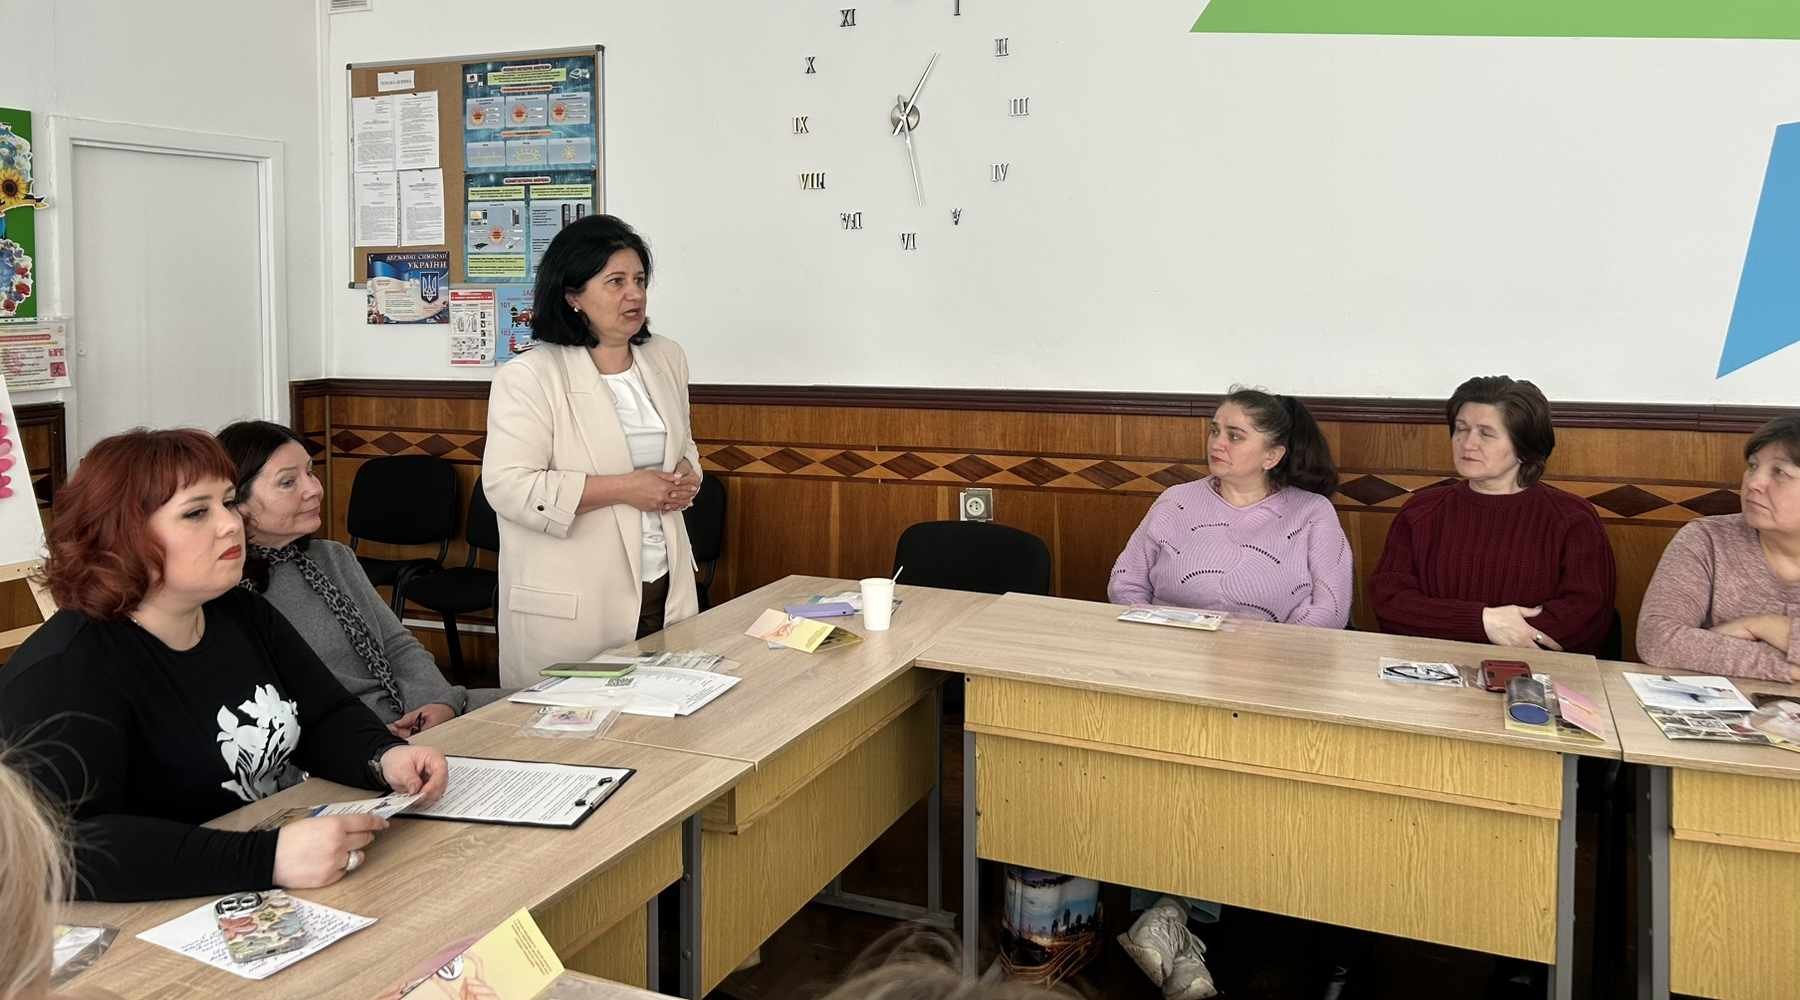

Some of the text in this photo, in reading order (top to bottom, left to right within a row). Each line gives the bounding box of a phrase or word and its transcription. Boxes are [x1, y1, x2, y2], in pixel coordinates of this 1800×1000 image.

[840, 9, 856, 27] XI
[805, 56, 816, 74] X
[1009, 98, 1029, 117] III
[792, 117, 809, 135] IX
[799, 172, 826, 190] VIII
[991, 163, 1009, 182] IV
[840, 212, 863, 230] VII
[951, 208, 962, 226] V
[901, 233, 917, 251] VI
[407, 260, 448, 270] УКРАЇНИ
